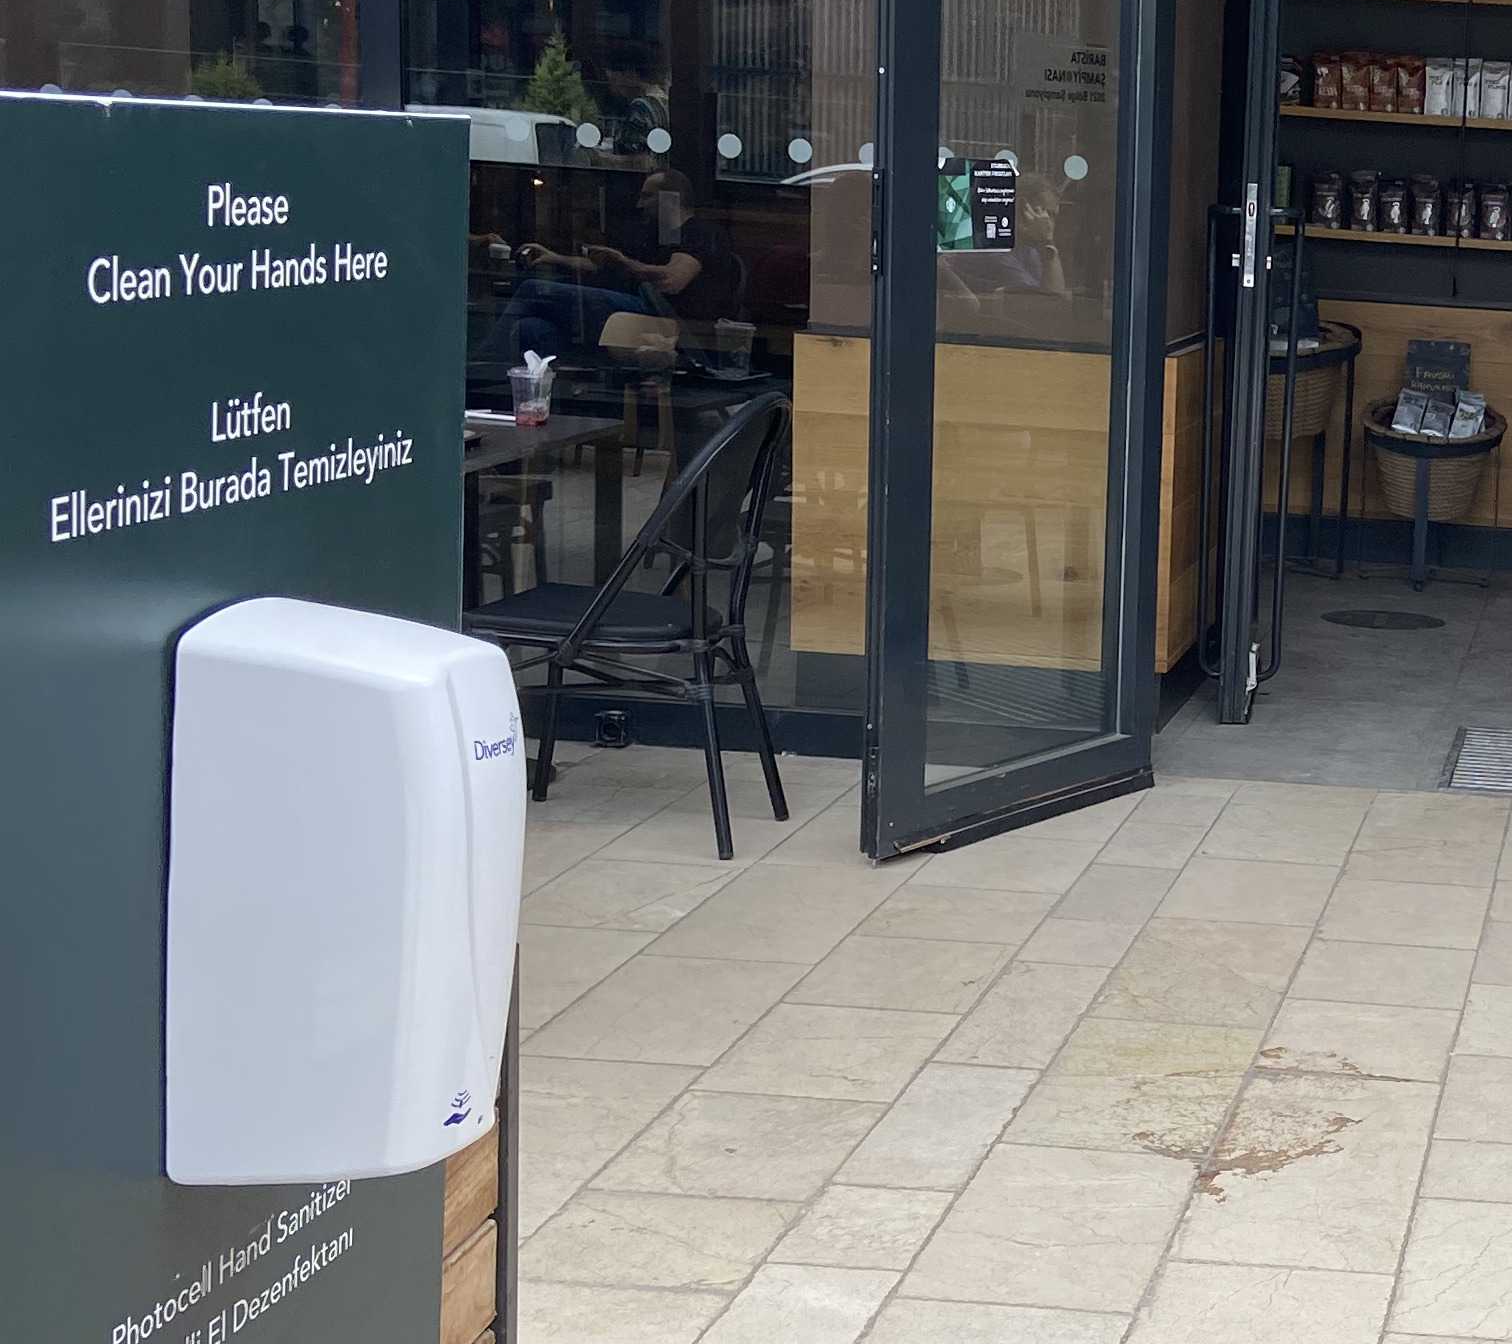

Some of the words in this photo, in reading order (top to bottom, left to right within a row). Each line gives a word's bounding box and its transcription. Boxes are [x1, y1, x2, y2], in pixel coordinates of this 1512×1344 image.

[207, 182, 289, 227] Please
[87, 256, 171, 304] Clean
[179, 253, 243, 296] Your
[251, 244, 327, 289] Hands
[334, 242, 388, 281] Here
[212, 391, 291, 443] Lütfen
[50, 475, 171, 542] Ellerinizi
[181, 457, 272, 513] Burada
[278, 430, 413, 490] Temizleyiniz
[219, 1220, 272, 1285] Hand
[233, 1227, 353, 1334] Dezenfektanı
